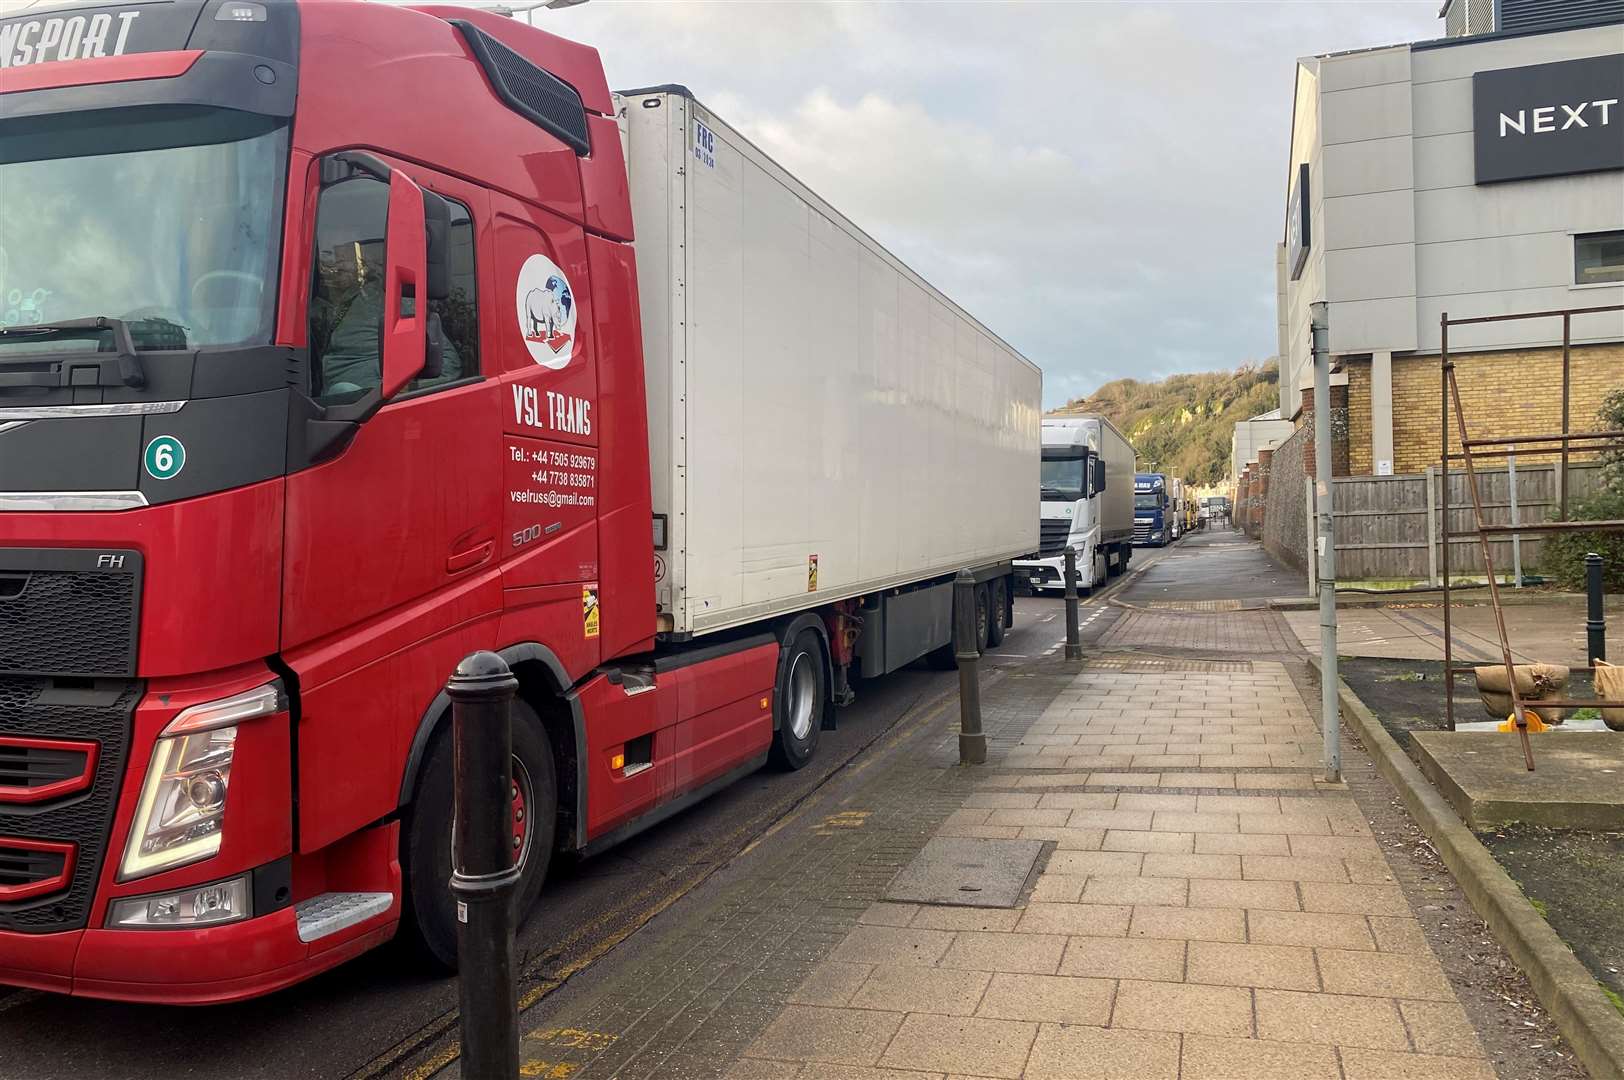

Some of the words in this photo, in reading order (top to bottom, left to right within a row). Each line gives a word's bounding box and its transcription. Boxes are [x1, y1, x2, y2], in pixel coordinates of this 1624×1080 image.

[1499, 99, 1618, 137] NEXT
[697, 123, 713, 153] FRC
[512, 384, 543, 428] VSL
[546, 391, 591, 436] TRANS
[155, 444, 174, 472] 6
[509, 446, 530, 462] Tel.:
[531, 450, 548, 465] +44
[549, 451, 569, 467] 7505
[570, 454, 596, 470] 929679
[531, 469, 548, 484] +44
[549, 471, 568, 486] 7738
[569, 473, 595, 488] 835871
[510, 488, 595, 508] vselruss@gmail.com
[512, 523, 541, 547] 500
[96, 554, 124, 568] FH
[655, 560, 661, 578] 2
